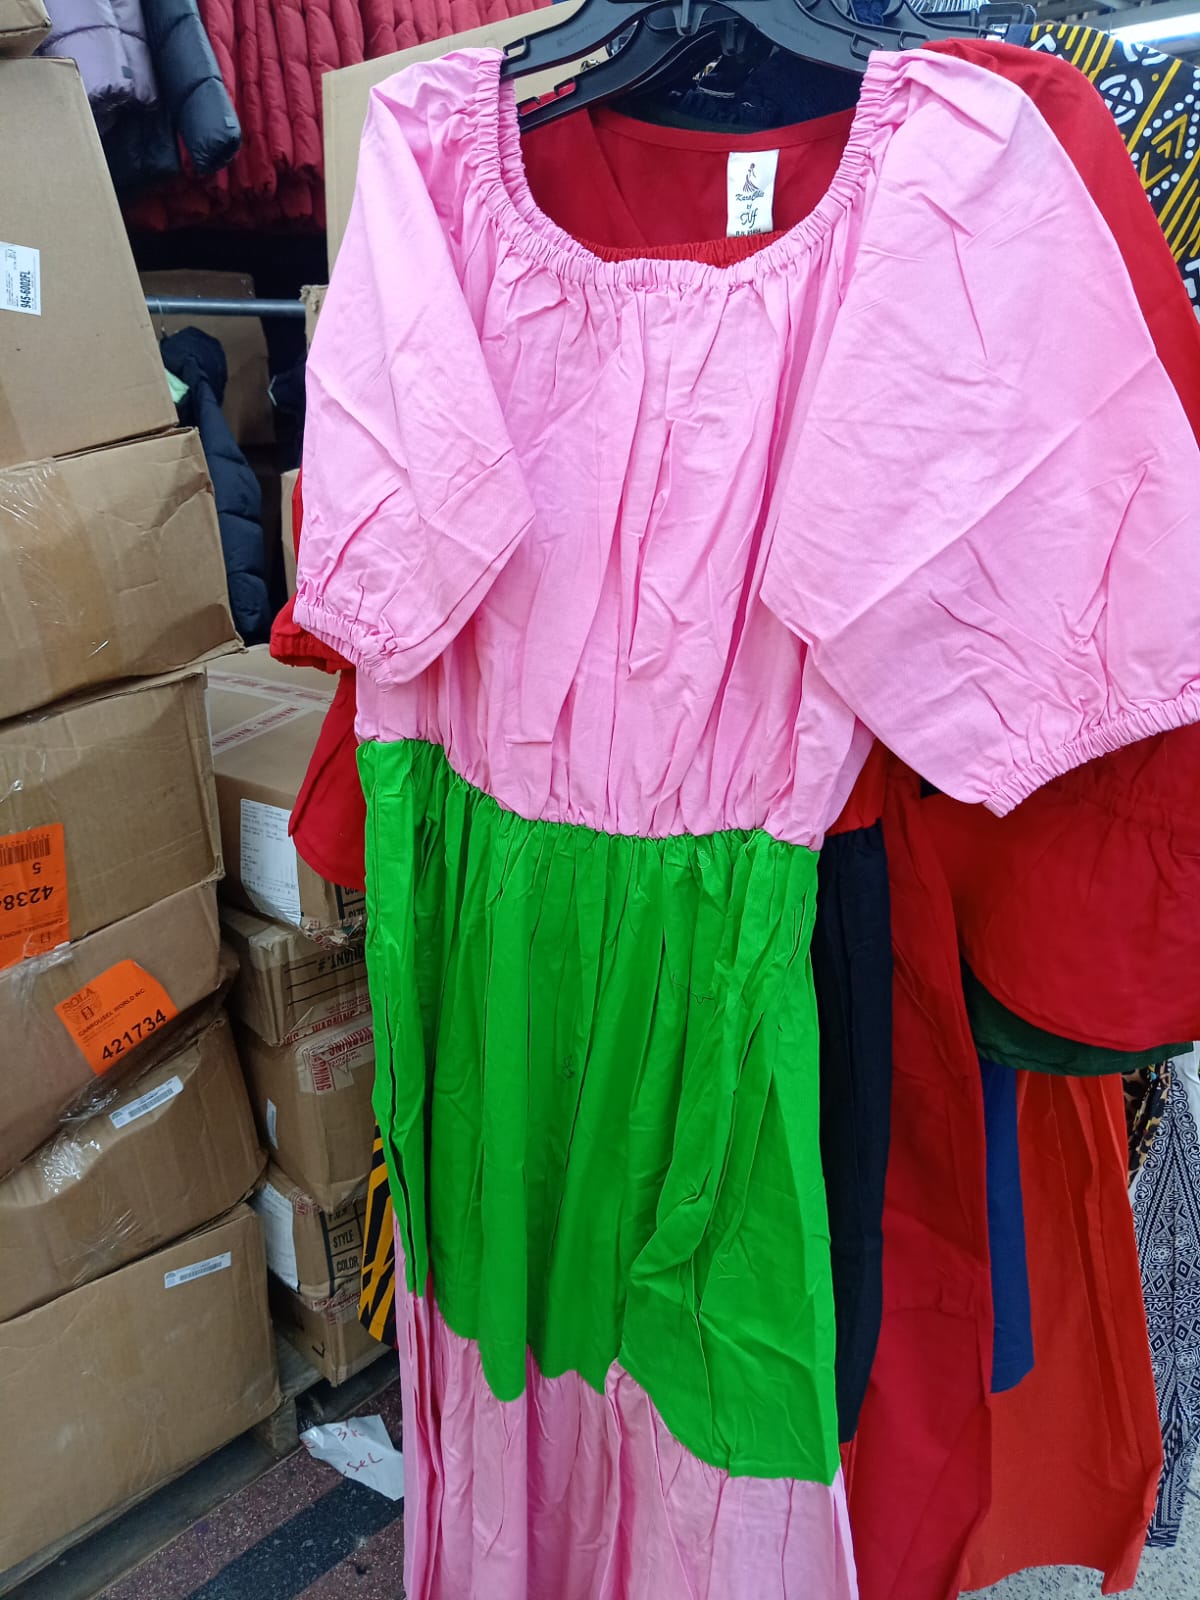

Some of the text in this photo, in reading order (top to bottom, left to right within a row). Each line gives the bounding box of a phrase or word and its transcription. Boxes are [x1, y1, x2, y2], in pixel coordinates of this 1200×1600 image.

[32, 862, 41, 875] 5
[0, 885, 54, 911] 4238
[62, 987, 96, 1010] SOLA
[102, 1008, 167, 1060] 421734
[333, 1229, 353, 1249] STYLE
[336, 1255, 358, 1272] COLOR
